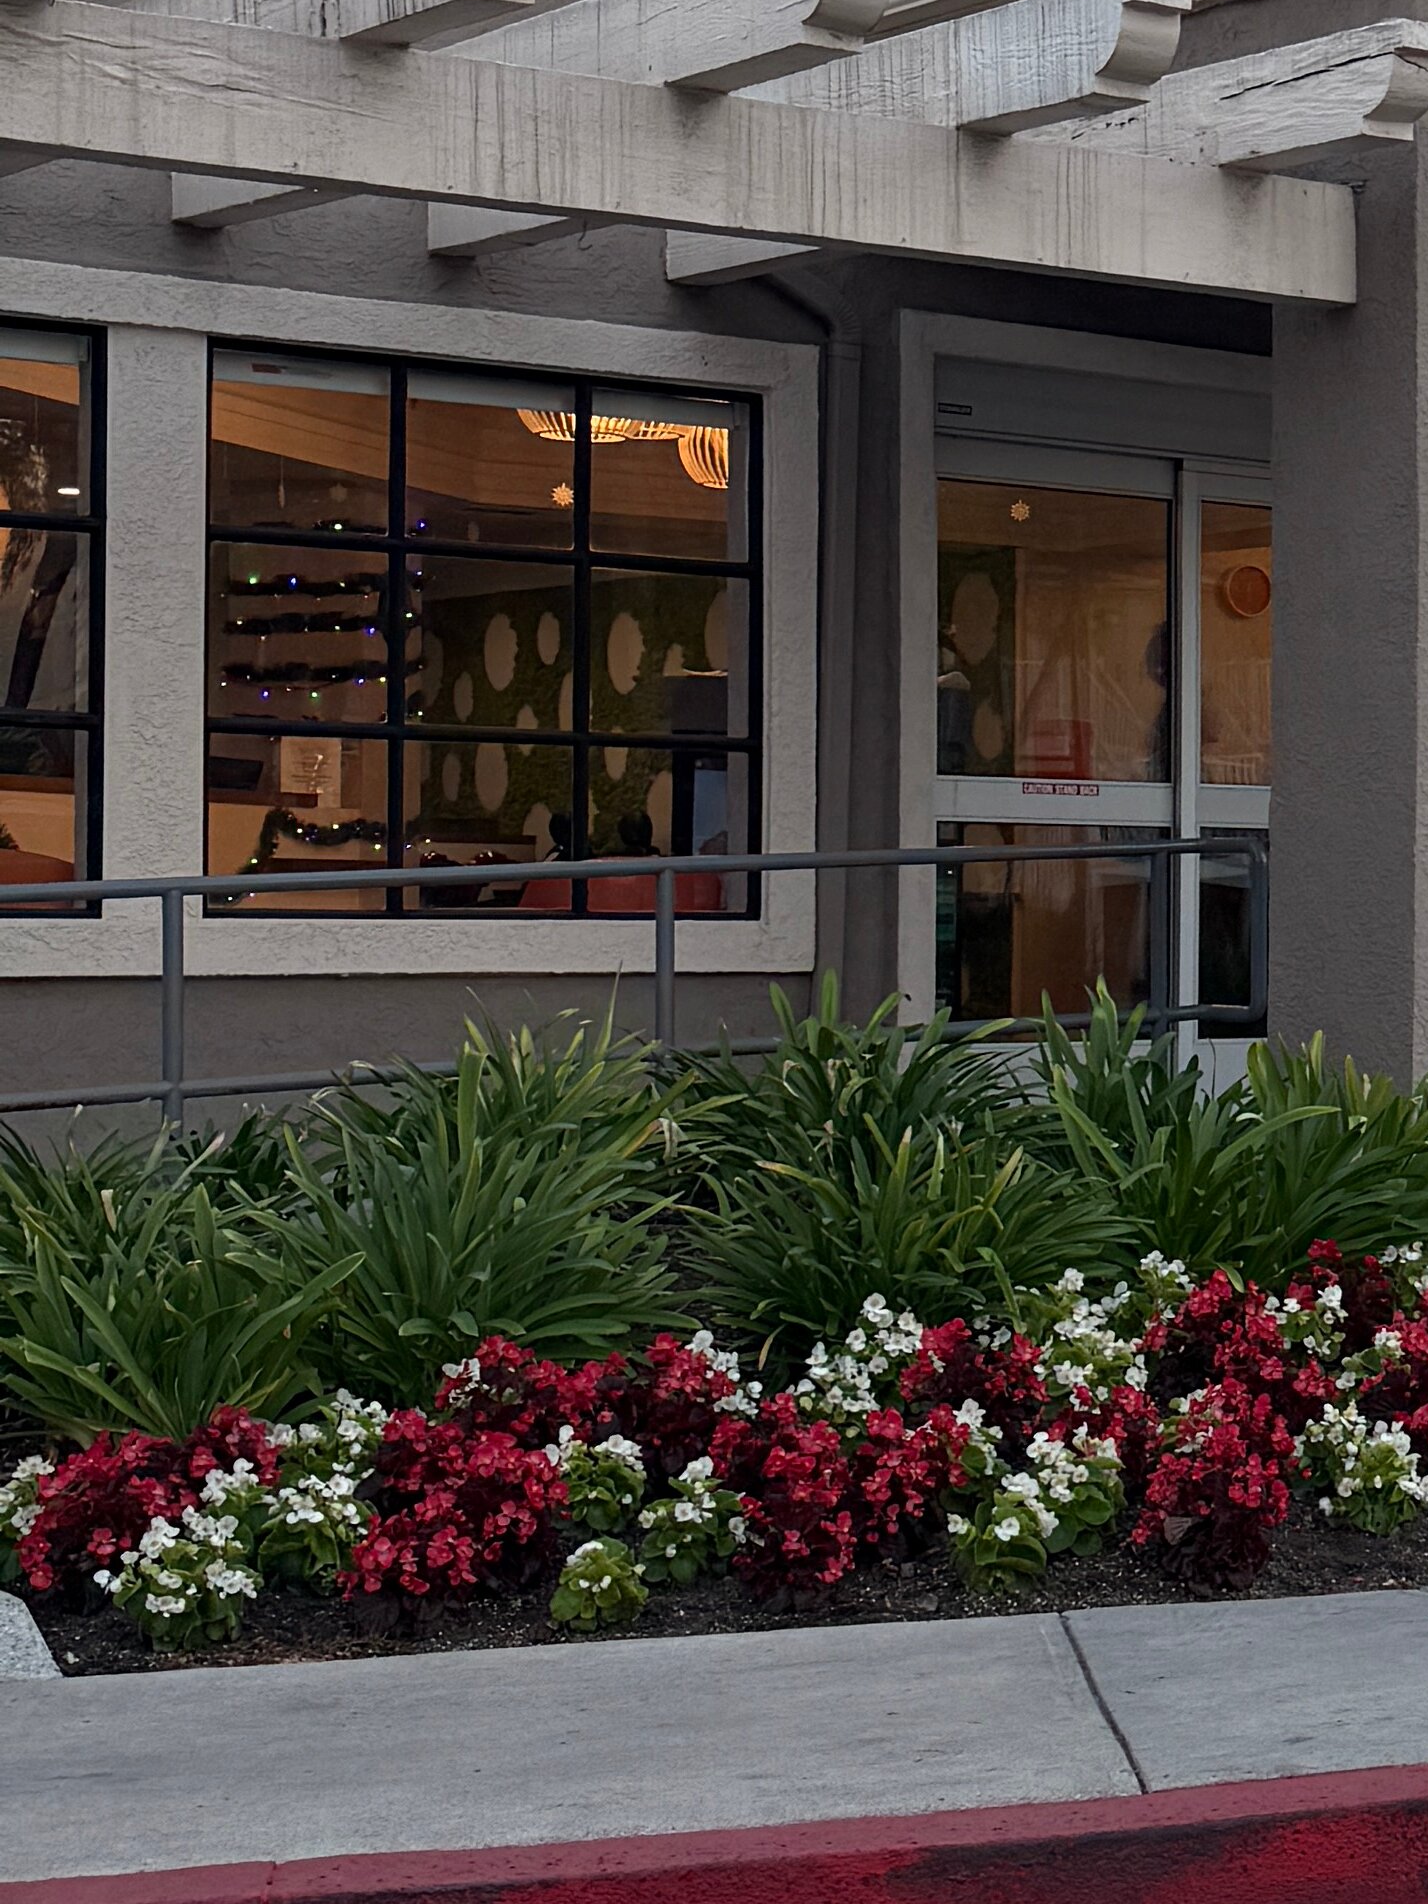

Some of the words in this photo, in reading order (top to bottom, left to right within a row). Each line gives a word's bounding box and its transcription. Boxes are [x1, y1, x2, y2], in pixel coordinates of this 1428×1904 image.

[1023, 782, 1054, 794] CAUTION
[1055, 783, 1078, 795] STAND
[1080, 784, 1098, 796] BACK
